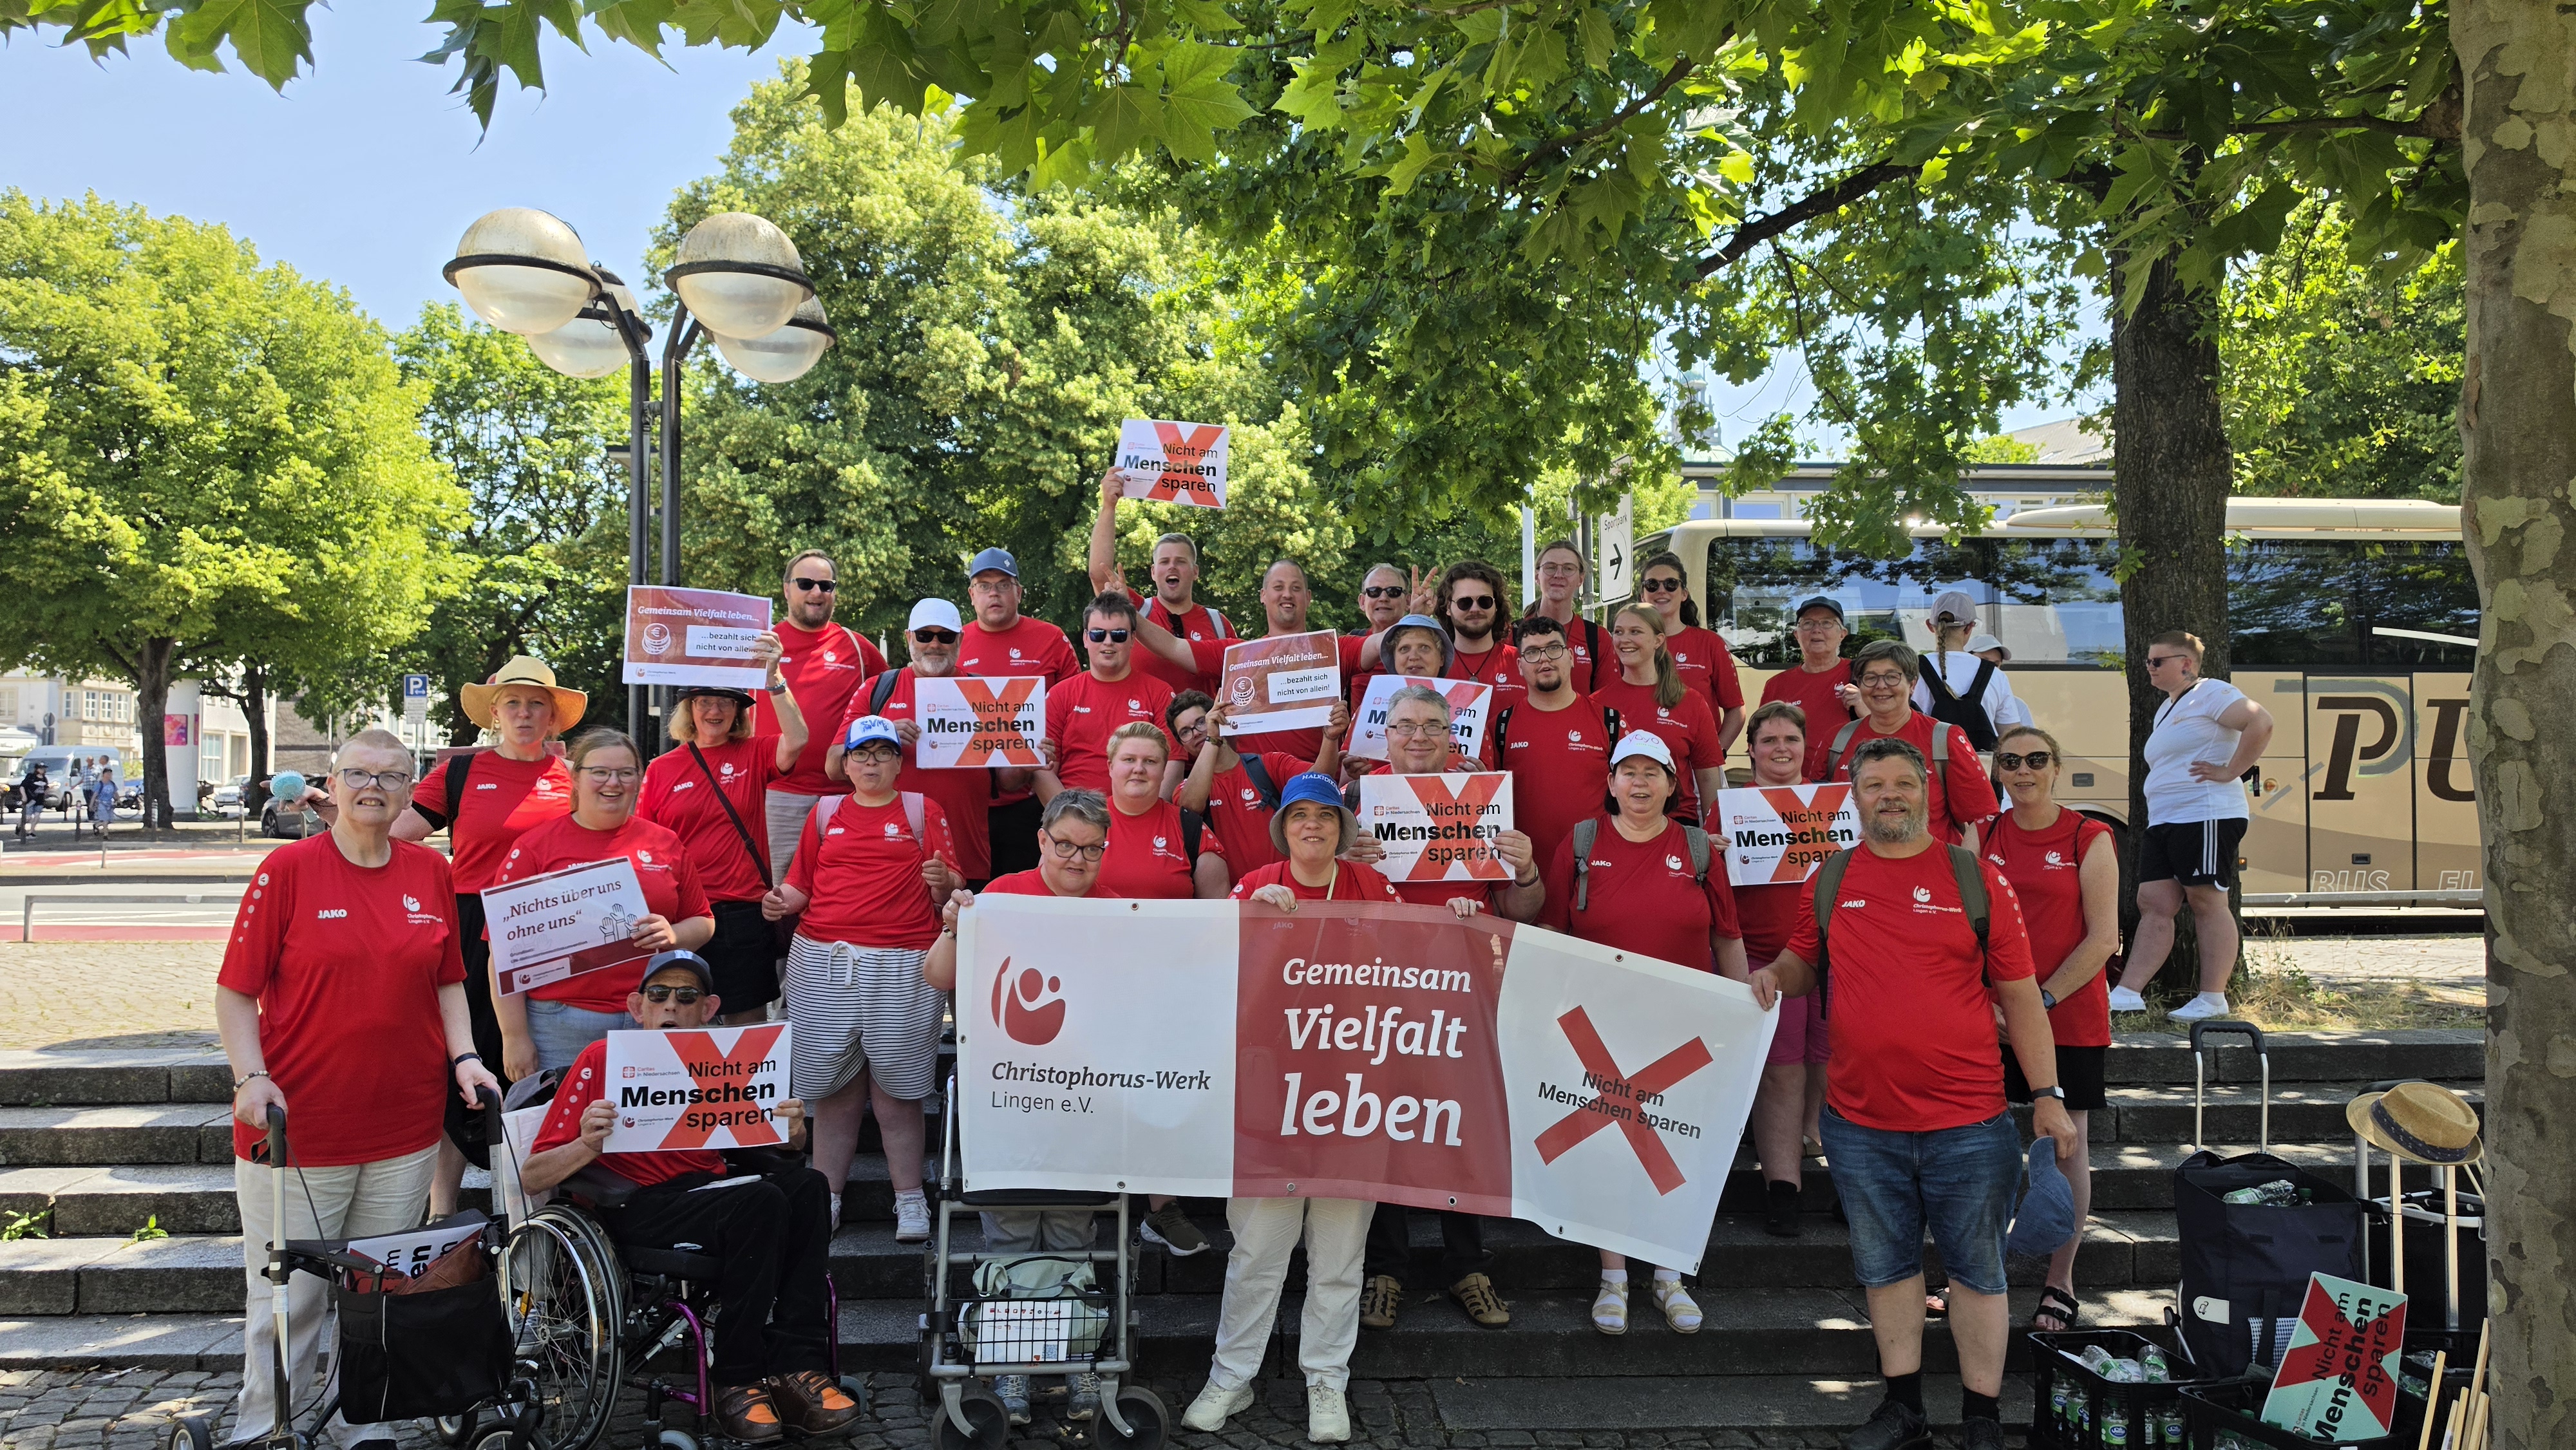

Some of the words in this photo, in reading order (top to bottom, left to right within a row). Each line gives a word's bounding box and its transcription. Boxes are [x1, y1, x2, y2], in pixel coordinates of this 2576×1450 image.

[1163, 443, 1195, 456] Nicht
[1199, 449, 1218, 458] am
[1124, 455, 1217, 476] Menschen
[1161, 478, 1217, 493] sparen
[1604, 514, 1627, 532] Sportpark
[638, 606, 692, 616] Gemeinsam
[693, 608, 727, 619] Vielfalt
[728, 612, 759, 622] leben...
[1229, 659, 1270, 672] Gemeinsam
[1271, 654, 1300, 666] Vielfalt
[1300, 652, 1329, 661] leben...
[410, 677, 423, 695] P
[1280, 675, 1312, 685] ...bezahlt
[1314, 673, 1328, 681] sich
[1277, 688, 1294, 697] nicht
[1310, 684, 1330, 693] allein!
[972, 701, 1009, 713] Nicht
[1013, 702, 1034, 712] am
[1073, 705, 1091, 713] JAKO
[1454, 706, 1477, 719] am
[927, 717, 1034, 733] Menschen
[972, 738, 1034, 754] sparen
[1510, 741, 1529, 749] JAKO
[673, 781, 694, 793] JAKO
[1426, 802, 1471, 816] Nicht
[1475, 803, 1501, 815] am
[1782, 810, 1823, 824] Nicht
[1827, 811, 1851, 821] am
[1374, 821, 1501, 841] Menschen
[1735, 827, 1853, 847] Menschen
[1427, 845, 1501, 865] sparen
[2310, 869, 2390, 892] BUS
[562, 887, 595, 904] über
[598, 880, 622, 895] uns
[1842, 899, 1866, 908] JAKO
[1913, 903, 1962, 913] Christophorus-Werk
[317, 909, 348, 919] JAKO
[507, 922, 545, 941] ohne
[1283, 957, 1471, 992] Gemeinsam
[1284, 1004, 1467, 1065] Vielfalt
[688, 1061, 742, 1077] Nicht
[748, 1059, 776, 1074] am
[992, 1061, 1211, 1090] Christophorus-Werk
[621, 1082, 775, 1107] Menschen
[1582, 1071, 1632, 1098] Nicht
[1635, 1089, 1664, 1107] am
[992, 1091, 1054, 1113] Lingen
[1061, 1097, 1094, 1114] e.V.
[1280, 1072, 1462, 1146] leben
[1538, 1081, 1632, 1121] Menschen
[1636, 1111, 1701, 1139] sparen
[686, 1107, 773, 1132] sparen
[2312, 1327, 2342, 1380] Nicht
[2335, 1292, 2351, 1323] am
[2363, 1303, 2391, 1397] sparen
[2311, 1297, 2372, 1442] Menschen
[2304, 1386, 2319, 1420] Niedersachsen
